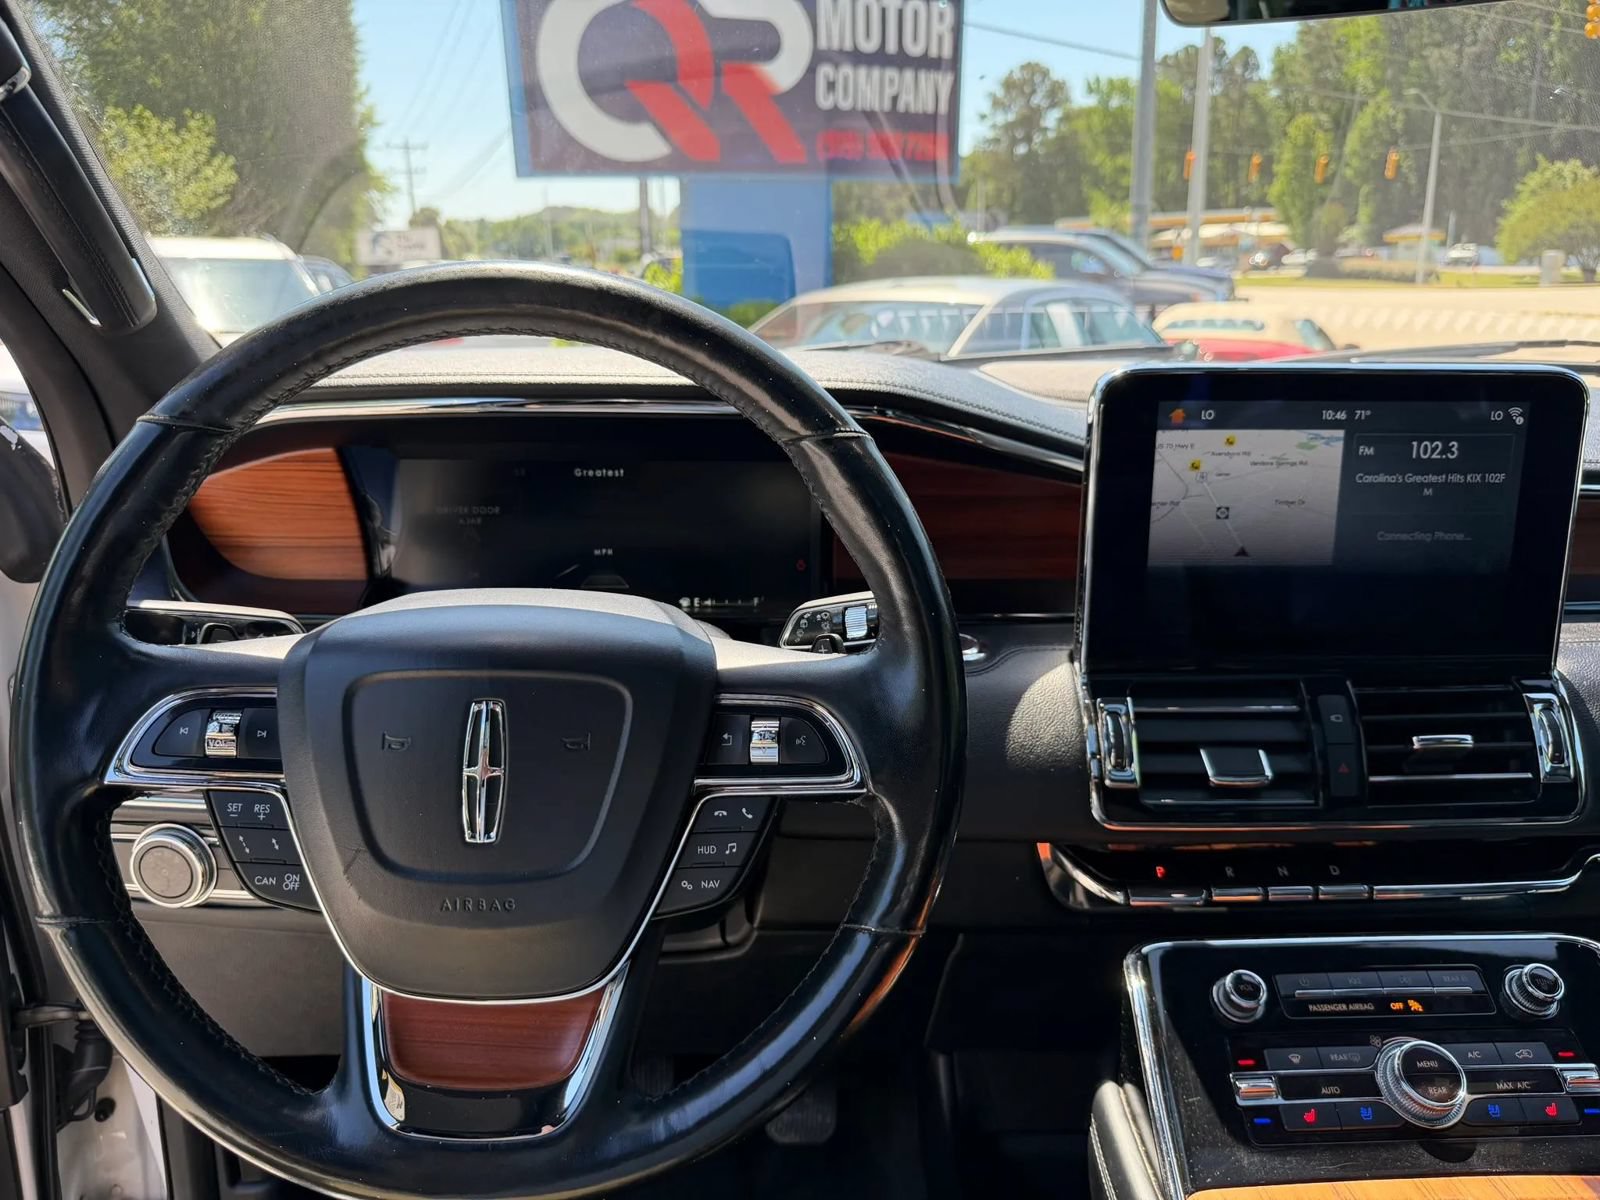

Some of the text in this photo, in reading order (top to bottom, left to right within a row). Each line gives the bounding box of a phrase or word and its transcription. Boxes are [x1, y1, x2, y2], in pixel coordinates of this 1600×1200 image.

[816, 0, 954, 59] MOTOR
[815, 63, 955, 115] COMPANY
[1201, 410, 1215, 420] LO
[1322, 410, 1347, 420] 10:46
[1490, 410, 1504, 421] LO
[1358, 446, 1375, 456] FM
[1411, 441, 1459, 459] 102.3
[574, 467, 625, 478] Greatest
[1355, 473, 1506, 483] Carolina's Greatest Hits KIX 102F
[1423, 488, 1433, 496] M
[1377, 531, 1432, 542] Connecting
[594, 548, 614, 556] MPH
[226, 803, 243, 812] SET
[254, 804, 271, 813] RES
[697, 845, 717, 854] HUD
[1155, 866, 1166, 878] P
[1225, 866, 1235, 877] R
[1277, 866, 1289, 877] N
[1329, 865, 1340, 876] D
[254, 876, 276, 885] CAN
[284, 873, 300, 881] ON
[283, 881, 300, 890] OFF
[701, 879, 721, 888] NAV
[440, 897, 516, 912] AIRBAG
[1308, 1002, 1375, 1012] PASSENGER AIRBAG
[1390, 1002, 1404, 1011] OFF
[1467, 1050, 1482, 1059] A/C
[1416, 1060, 1439, 1068] MENU
[1320, 1086, 1341, 1095] AUTO
[1427, 1086, 1447, 1095] REAR
[1495, 1081, 1531, 1090] MAX A/C
